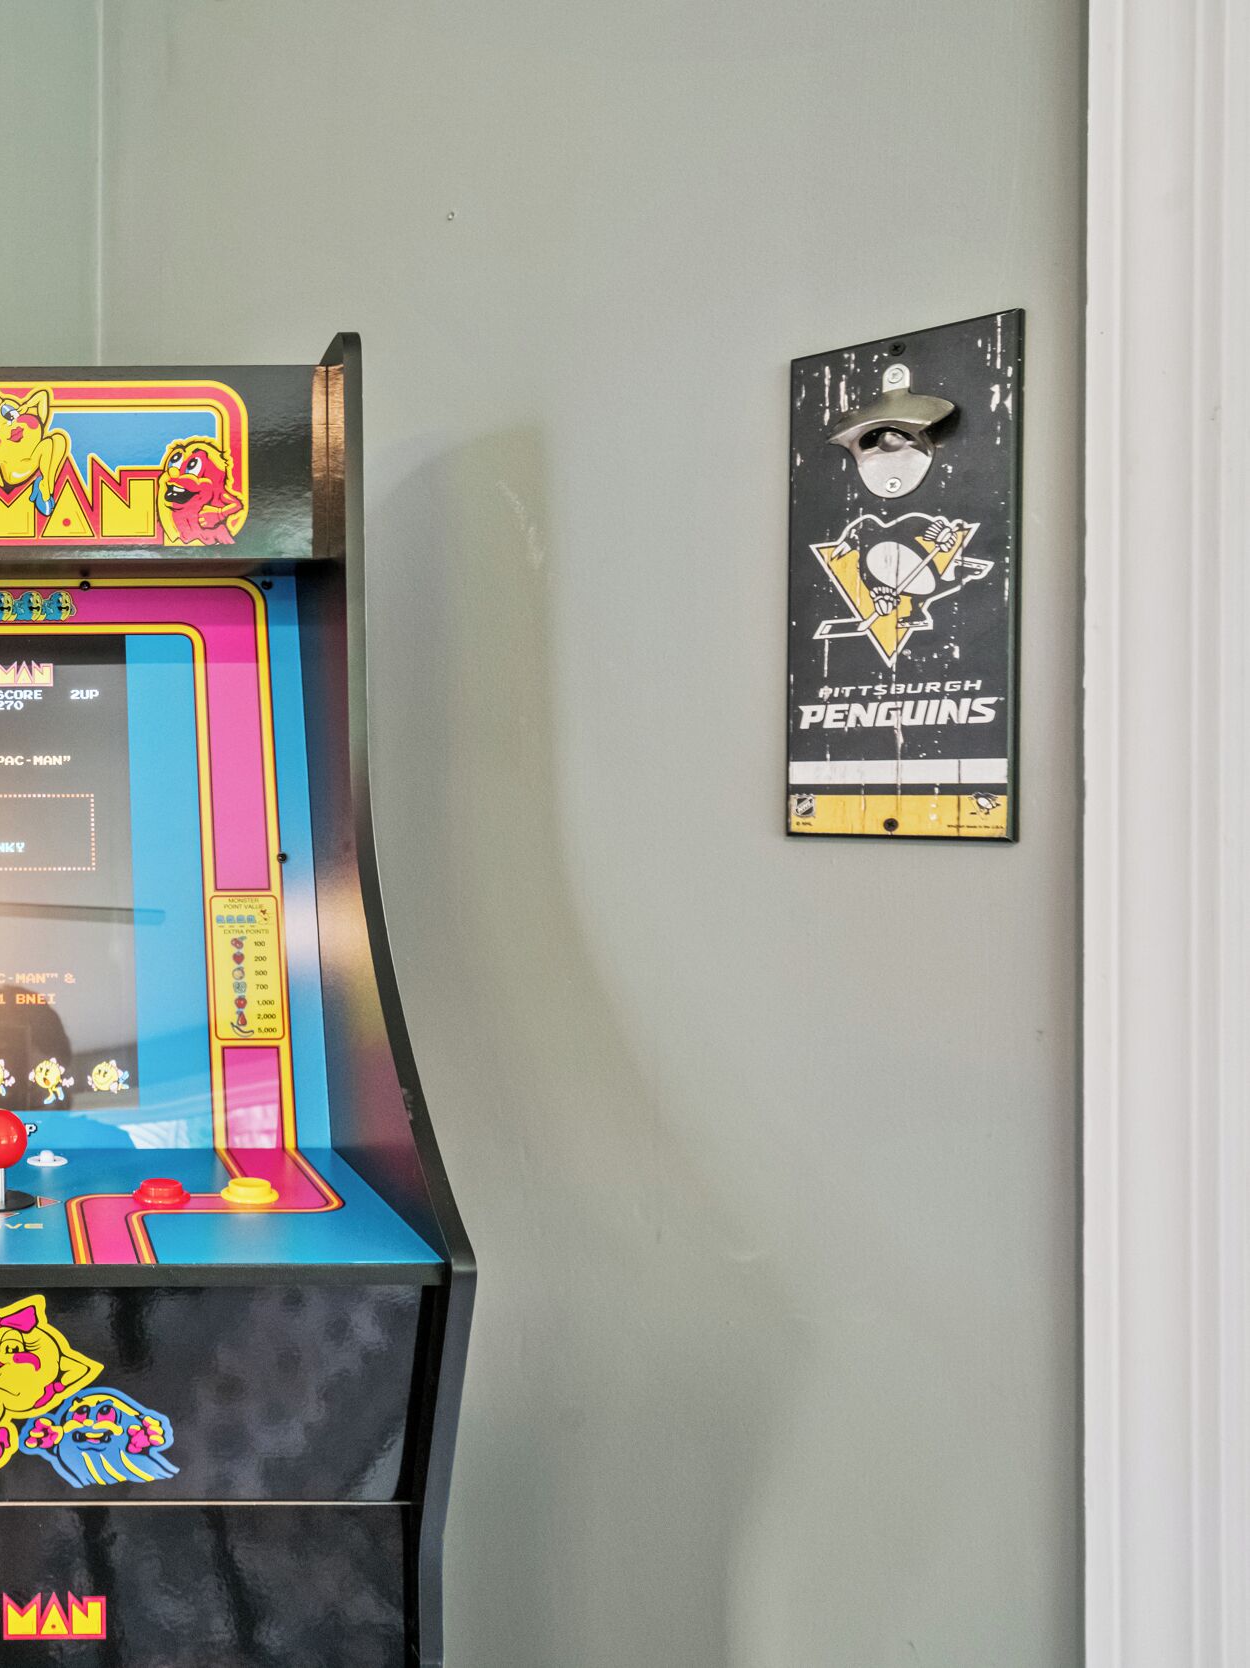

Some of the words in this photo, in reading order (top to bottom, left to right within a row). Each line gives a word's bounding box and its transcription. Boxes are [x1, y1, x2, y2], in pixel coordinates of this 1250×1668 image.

[70, 689, 100, 700] 2UP
[818, 680, 982, 698] PITTSBURGH
[798, 697, 1000, 729] PENGUINS
[64, 973, 76, 984] &
[15, 993, 56, 1005] BNEI
